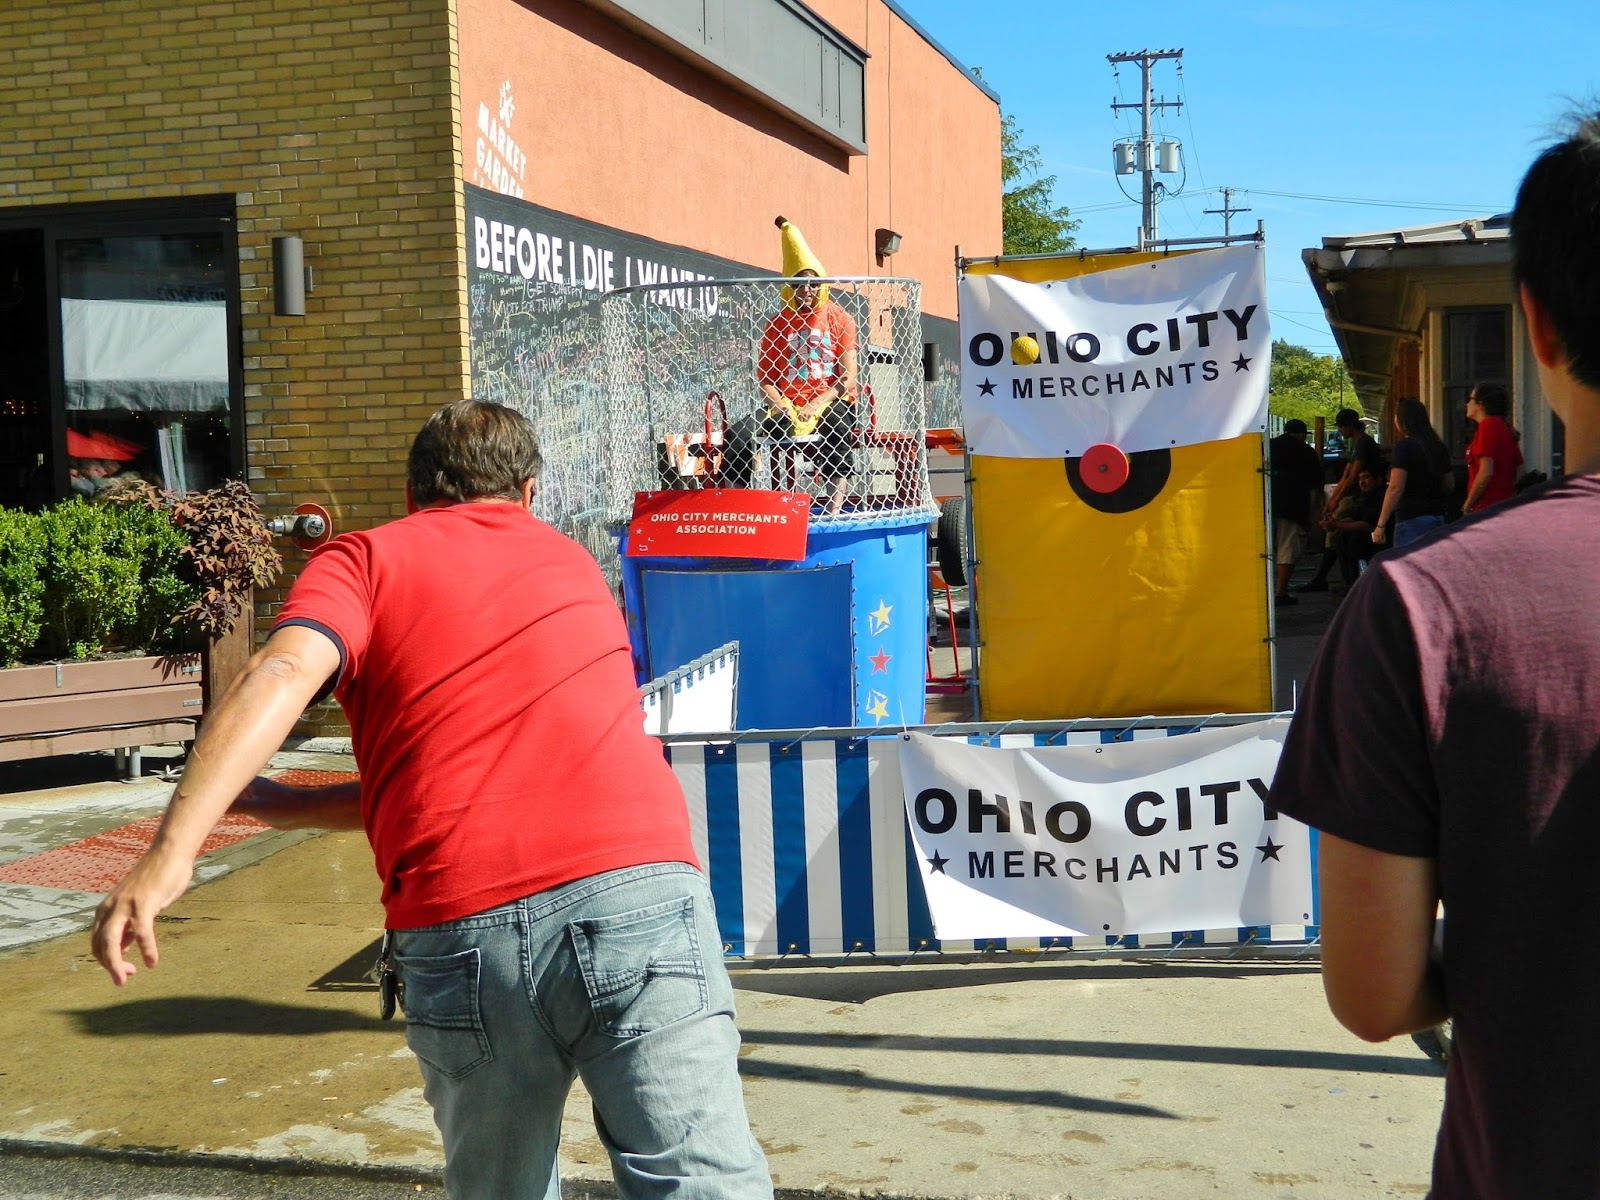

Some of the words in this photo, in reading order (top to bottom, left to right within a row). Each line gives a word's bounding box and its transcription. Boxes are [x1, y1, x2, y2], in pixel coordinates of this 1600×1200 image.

[477, 101, 526, 181] MARKET
[475, 216, 564, 284] BEFORE
[569, 241, 576, 288] I
[583, 244, 615, 292] DIE
[637, 259, 694, 309] WANT
[1126, 304, 1258, 356] CITY
[1012, 360, 1219, 399] MERCHANTS
[651, 512, 679, 522] OHIO
[682, 512, 709, 522] CITY
[712, 512, 788, 524] MERCHANTS
[676, 525, 757, 535] ASSOCIATION
[914, 788, 1092, 844] OHIO
[969, 841, 1239, 883] MERCHANTS
